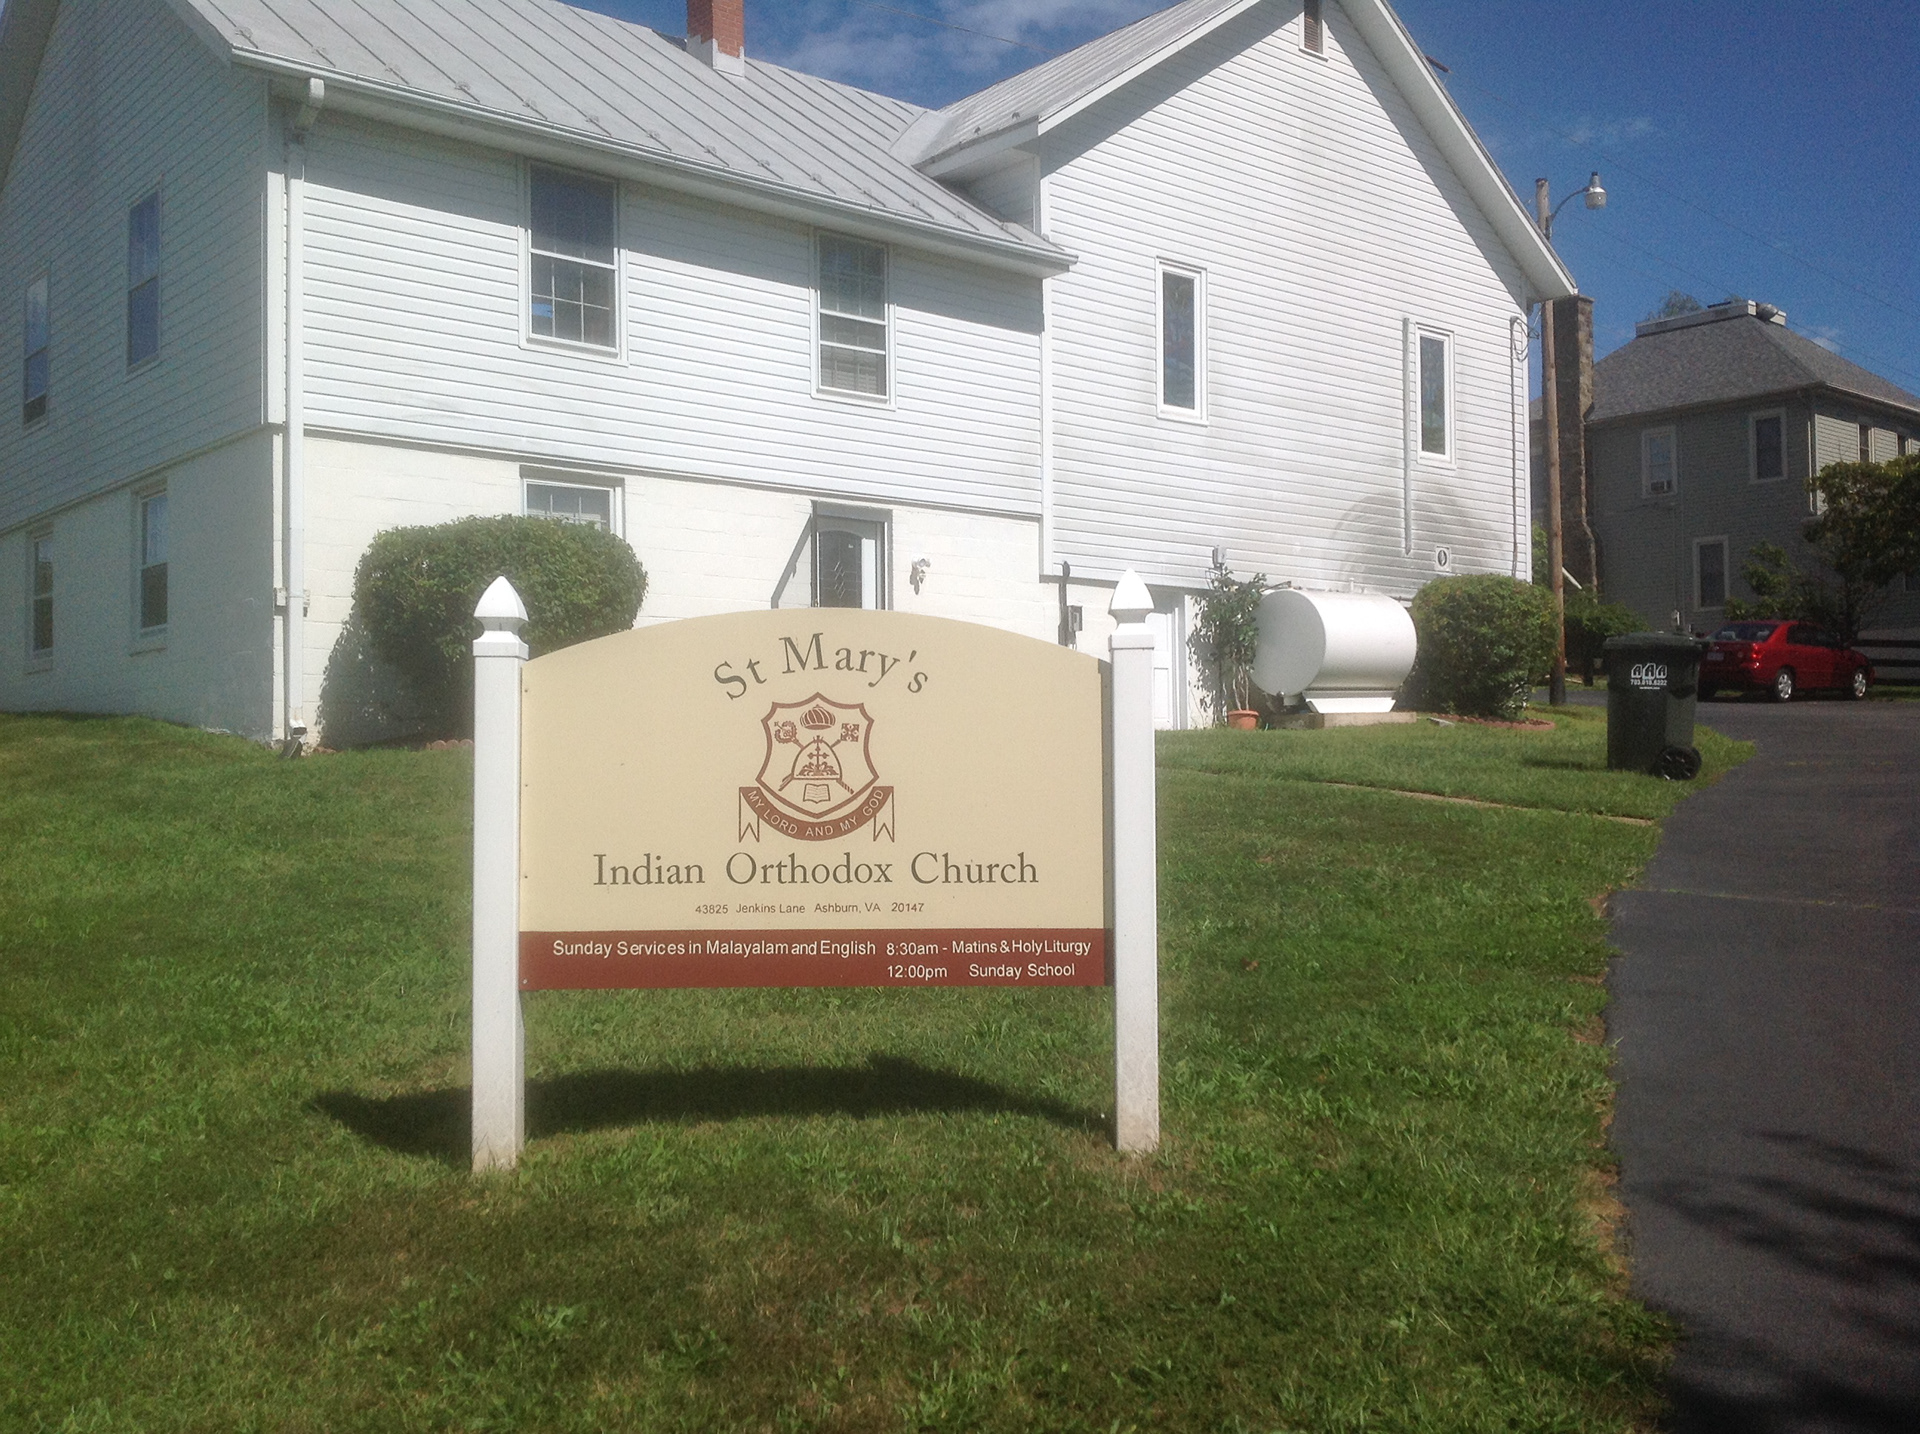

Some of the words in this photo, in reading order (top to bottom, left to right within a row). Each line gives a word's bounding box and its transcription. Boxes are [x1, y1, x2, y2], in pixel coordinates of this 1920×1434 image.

[714, 658, 767, 700] St
[779, 632, 928, 694] Mary's
[748, 789, 765, 809] MY
[763, 809, 798, 835] LORD
[805, 825, 834, 837] AND
[840, 816, 858, 832] MY
[862, 789, 884, 816] GOD
[593, 853, 705, 885] Indian
[726, 852, 893, 885] Orthodox
[911, 852, 1039, 884] Church
[695, 904, 729, 914] 43825
[736, 903, 776, 914] Jenkins
[779, 903, 806, 914] Lane
[814, 903, 862, 914] Ashburn,
[864, 903, 881, 913] VA
[891, 902, 925, 913] 20147
[553, 940, 612, 959] Sunday
[617, 941, 686, 956] Services
[688, 940, 702, 955] in
[706, 940, 789, 958] Malayalam
[791, 941, 817, 955] and
[820, 940, 876, 958] English
[886, 943, 939, 956] 8:30am
[952, 940, 997, 953] Matins
[1000, 940, 1010, 953] &
[1012, 940, 1043, 956] Holy
[1044, 940, 1091, 956] Liturgy
[887, 965, 948, 981] 12:00pm
[969, 963, 1022, 981] Sunday
[1027, 963, 1075, 977] School
